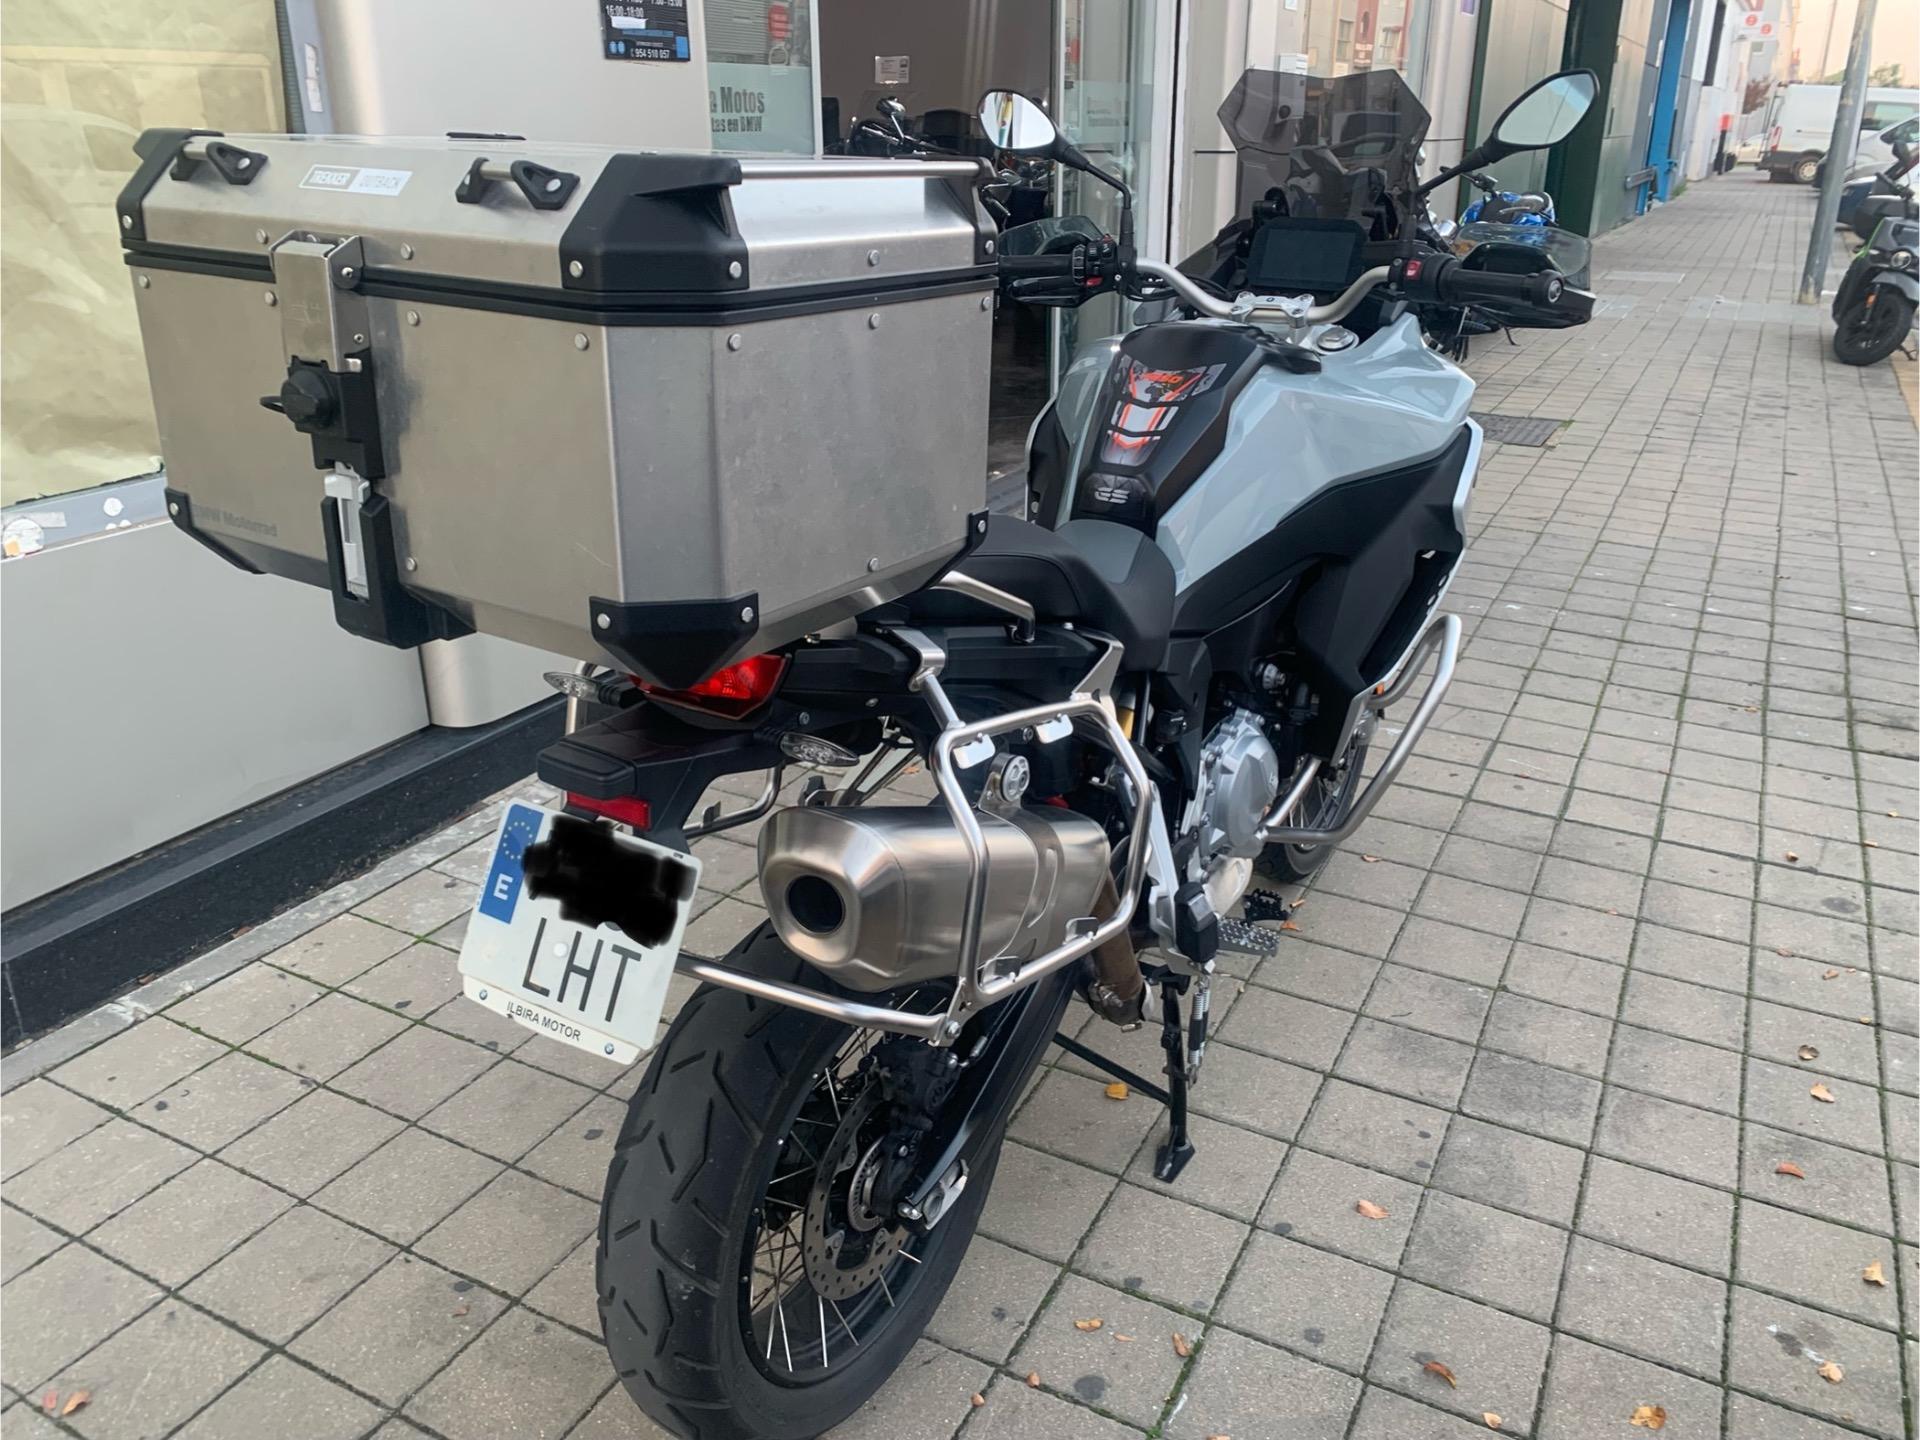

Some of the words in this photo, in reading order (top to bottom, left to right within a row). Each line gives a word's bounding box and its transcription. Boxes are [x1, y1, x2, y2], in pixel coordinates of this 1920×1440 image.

[635, 48, 647, 58] 954
[720, 86, 765, 114] Motos
[727, 118, 739, 132] en
[740, 115, 762, 132] BMW
[493, 872, 514, 901] E
[522, 917, 642, 1022] LHT
[506, 1001, 540, 1025] ILBIRA
[541, 1015, 582, 1042] MOTOR
